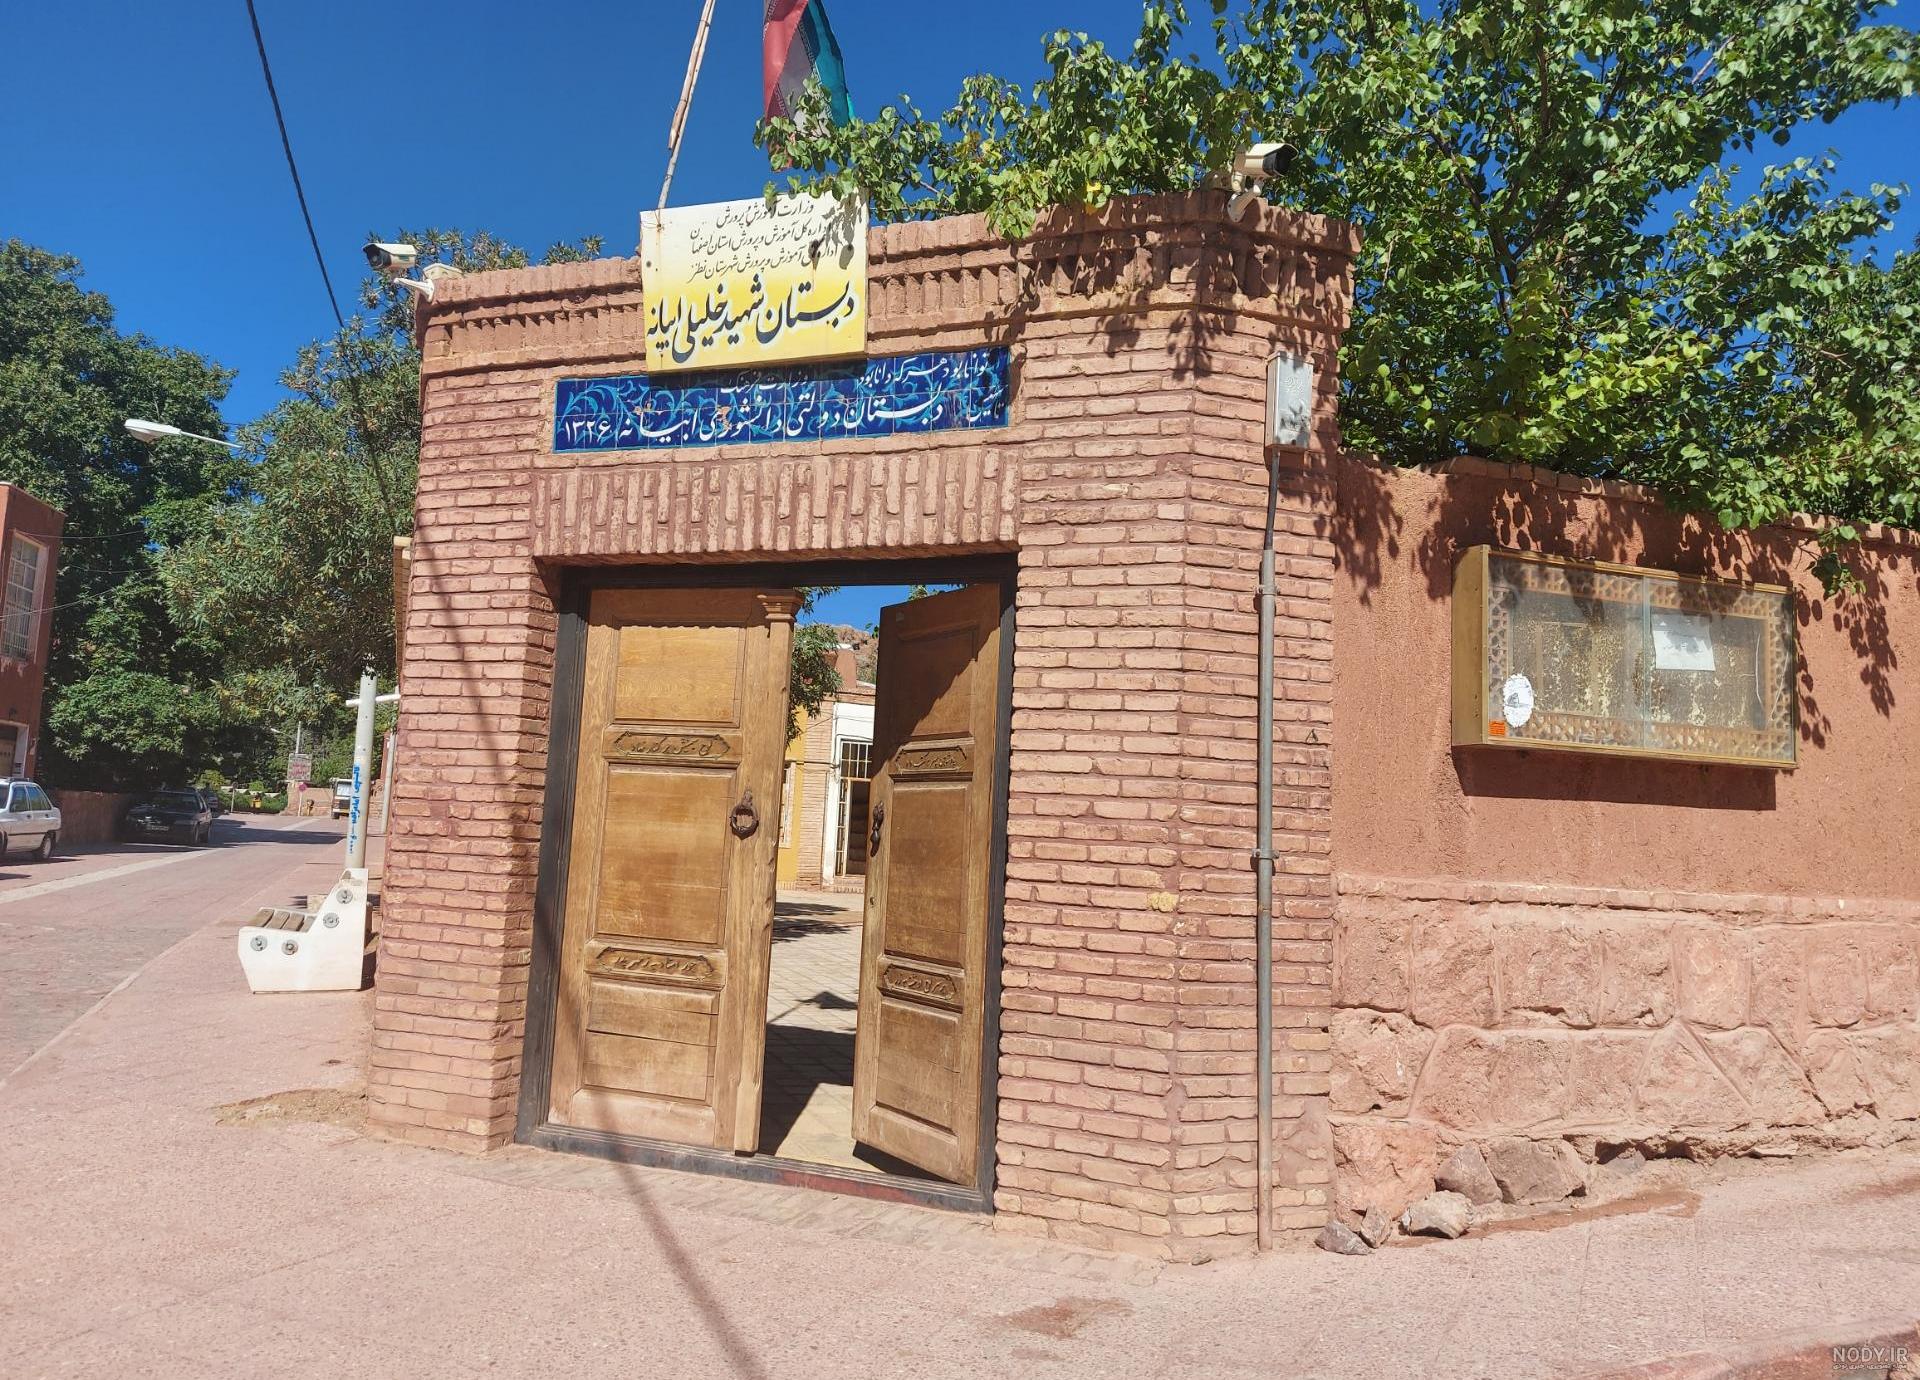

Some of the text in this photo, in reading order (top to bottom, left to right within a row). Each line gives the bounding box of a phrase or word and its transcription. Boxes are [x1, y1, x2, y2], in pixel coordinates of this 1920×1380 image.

[716, 206, 745, 229] پرورش
[778, 200, 814, 217] وزارت
[731, 230, 760, 252] پرورش
[764, 220, 800, 246] آموزش
[794, 217, 813, 241] کل
[706, 234, 732, 256] استان
[770, 244, 808, 269] آموزش
[686, 259, 707, 284] نطنز
[704, 254, 739, 280] شهرستان
[736, 252, 766, 273] پرورش
[646, 273, 855, 364] دبستان شهید خلیلی ابیانه
[786, 390, 840, 437] دولتی
[843, 381, 943, 429] دبستان
[565, 420, 611, 443] ۱۳۲۶
[619, 409, 698, 443] ابیانه
